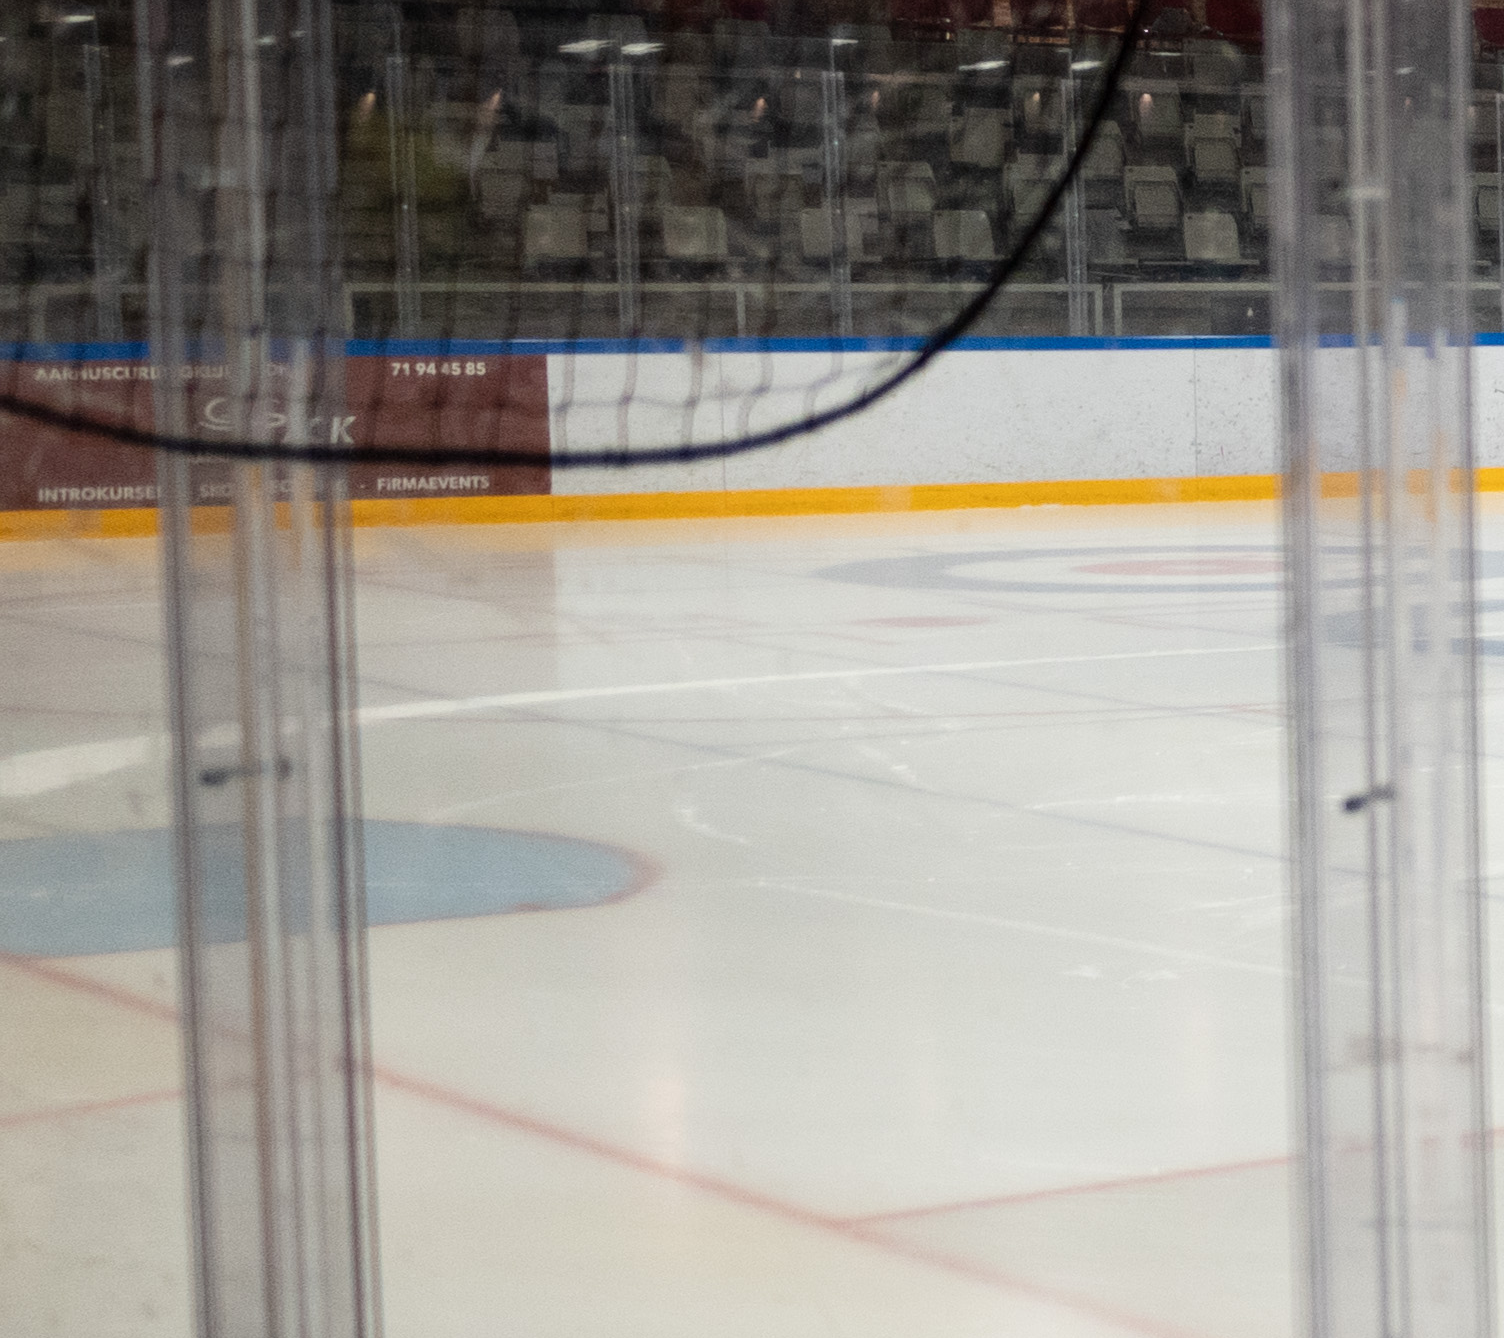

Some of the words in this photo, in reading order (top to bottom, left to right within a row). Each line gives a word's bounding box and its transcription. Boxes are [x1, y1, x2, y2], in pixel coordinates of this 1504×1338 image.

[391, 362, 411, 377] 71
[415, 362, 437, 377] 94
[465, 361, 487, 376] 85
[377, 475, 490, 492] FIRMAEVENTS
